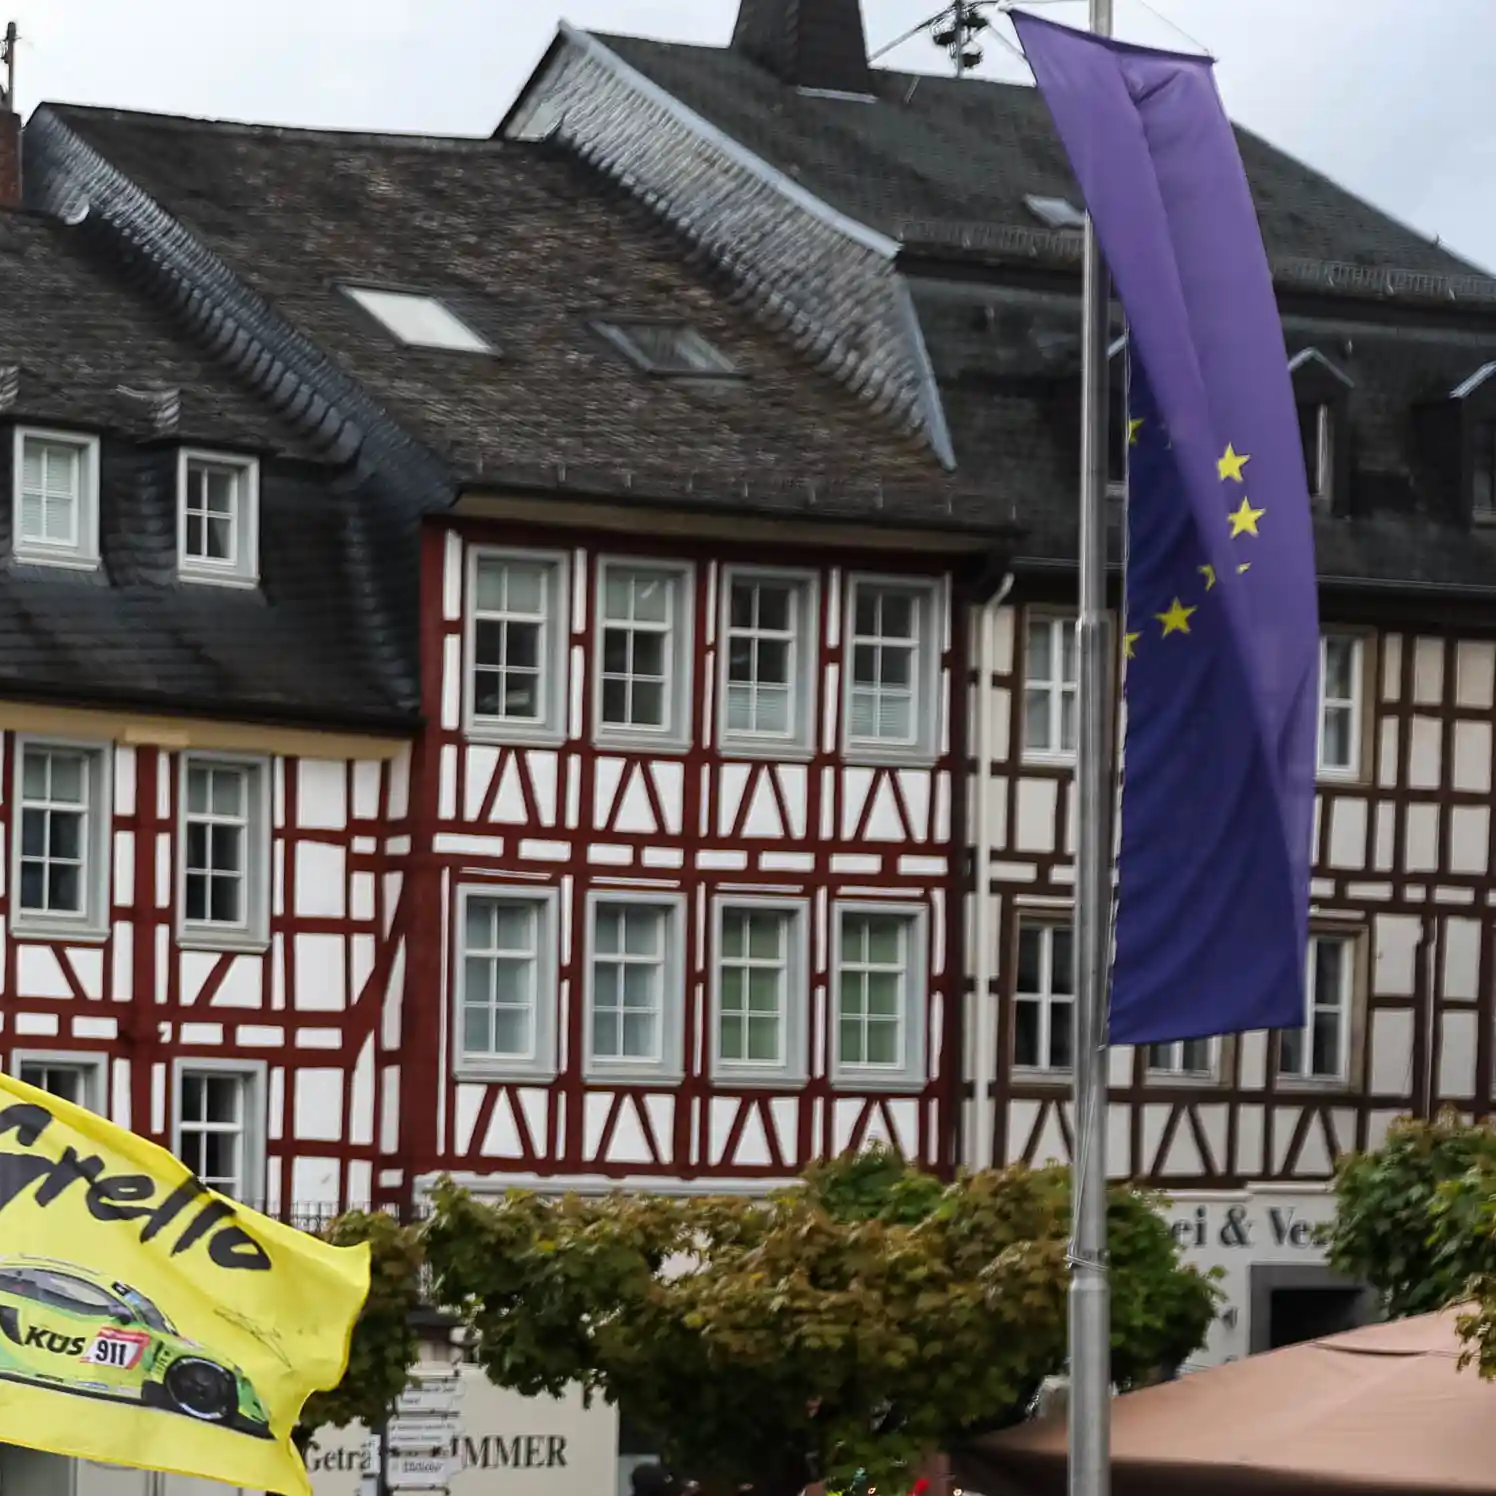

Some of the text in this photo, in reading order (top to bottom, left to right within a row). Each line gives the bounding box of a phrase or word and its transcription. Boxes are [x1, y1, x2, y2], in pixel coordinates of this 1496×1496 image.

[1171, 1205, 1208, 1247] ei
[1220, 1204, 1256, 1248] &
[95, 1339, 128, 1366] 911
[305, 1440, 370, 1472] Geträ
[450, 1434, 568, 1469] IMMER
